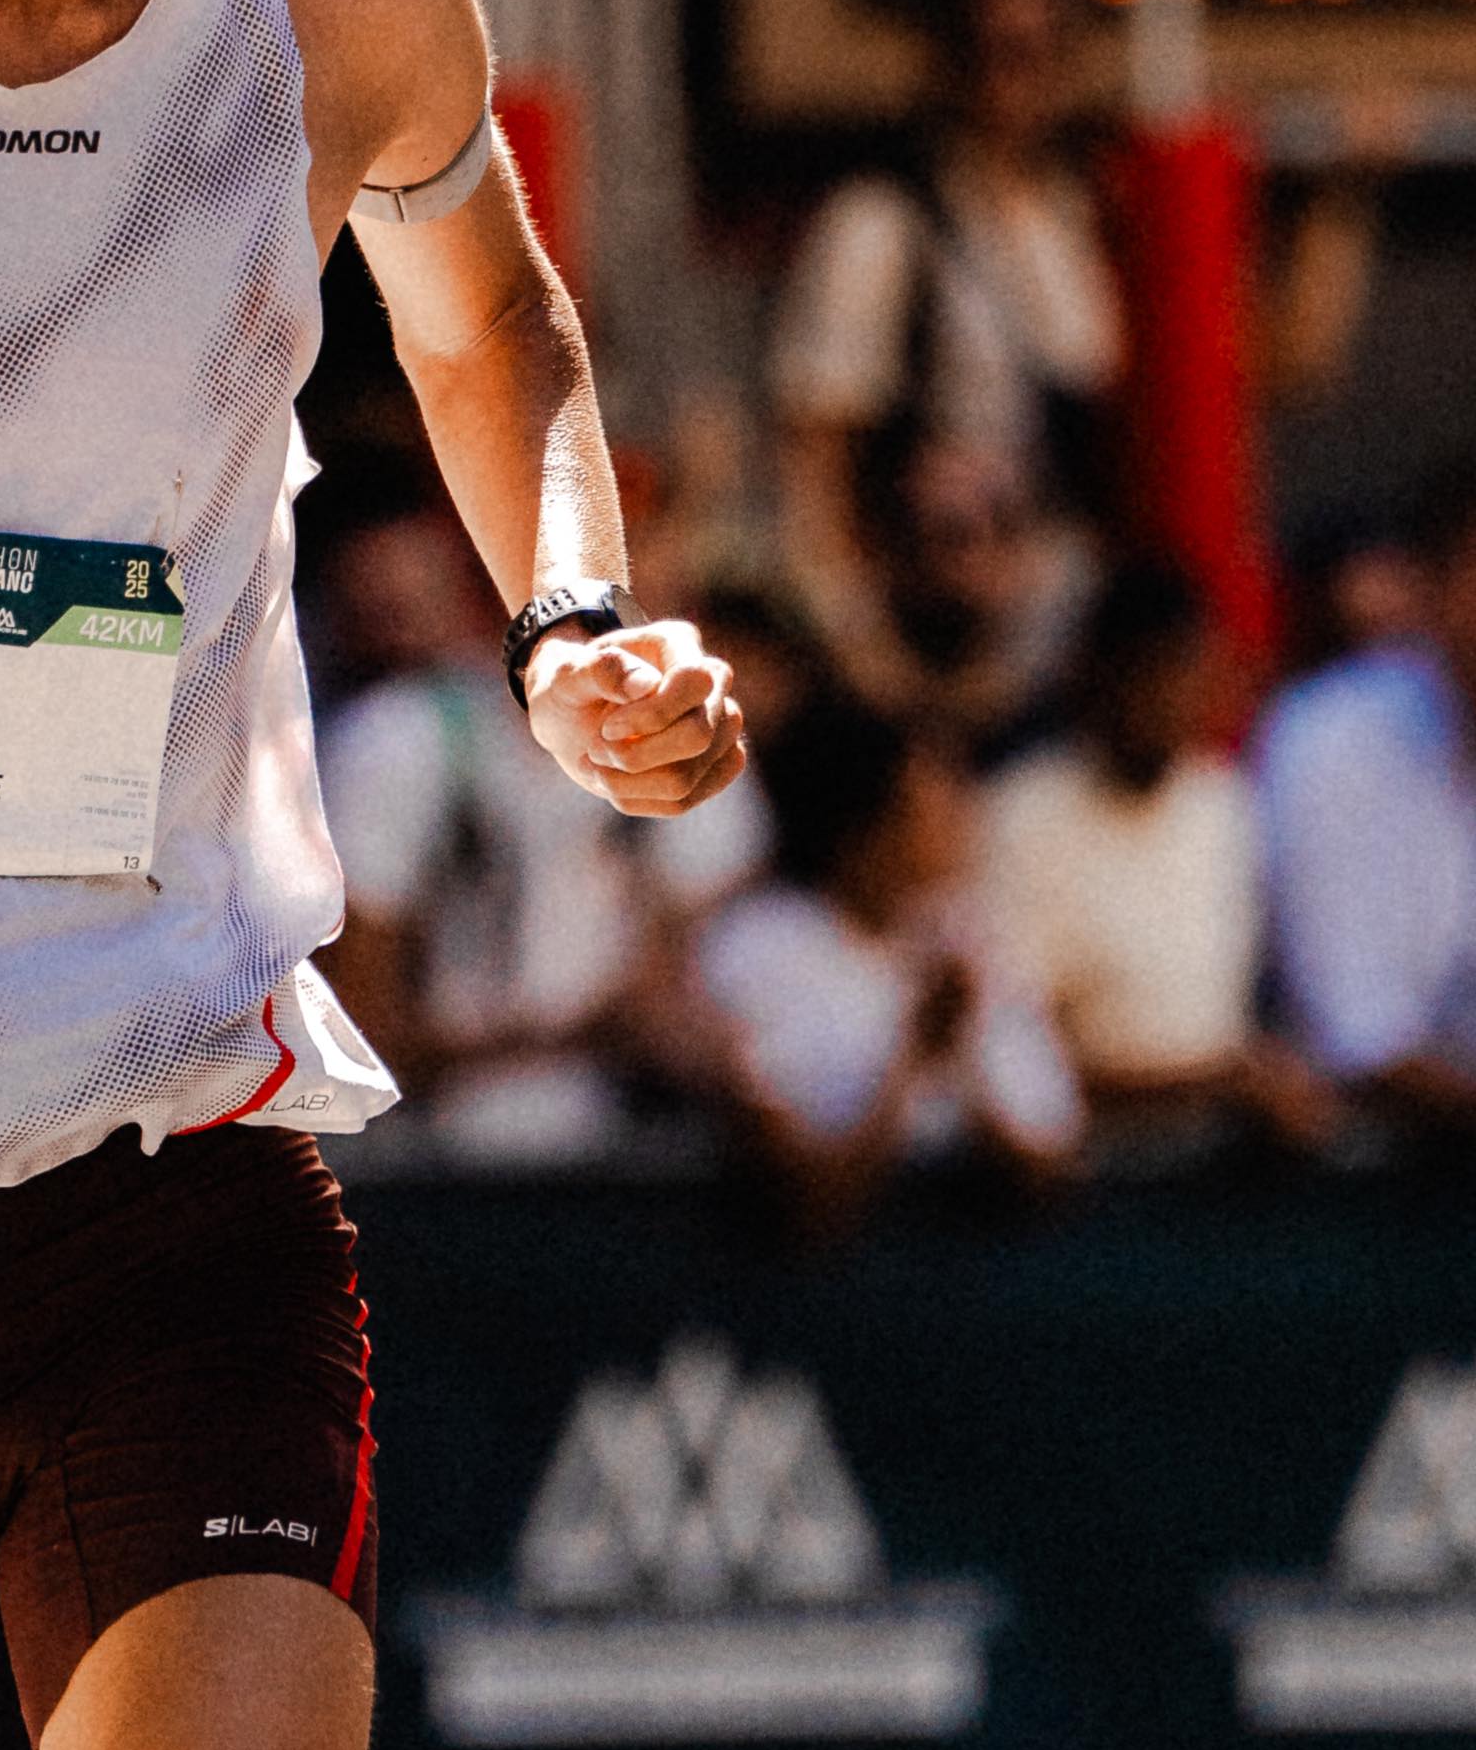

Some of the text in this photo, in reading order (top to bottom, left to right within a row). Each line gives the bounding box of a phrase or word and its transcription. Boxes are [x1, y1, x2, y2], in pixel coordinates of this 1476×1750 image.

[126, 560, 149, 580] 20
[124, 579, 148, 599] 25
[79, 613, 164, 647] 42KM
[123, 855, 140, 870] 13
